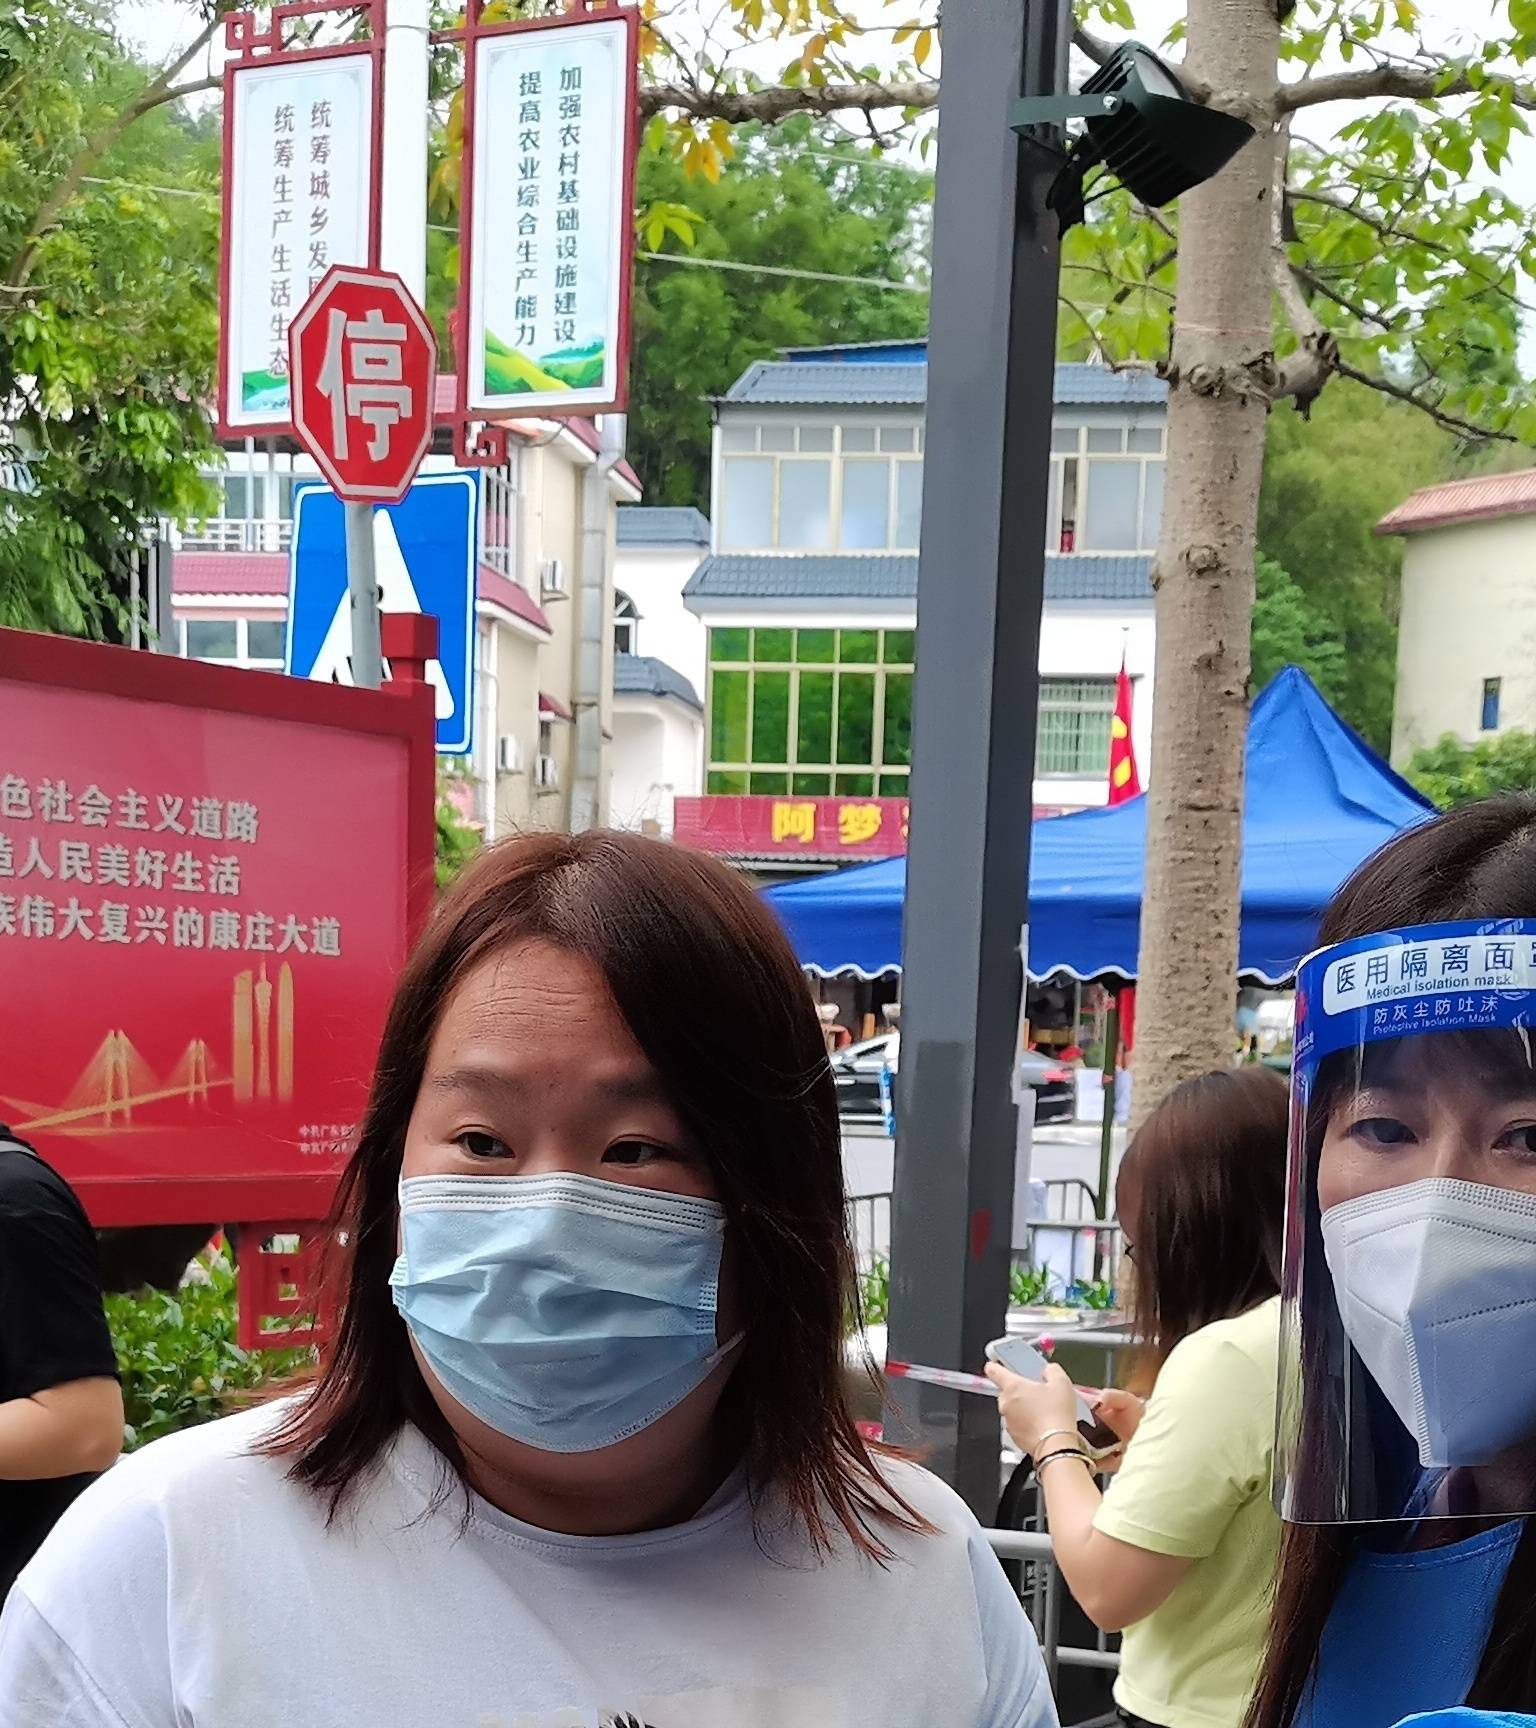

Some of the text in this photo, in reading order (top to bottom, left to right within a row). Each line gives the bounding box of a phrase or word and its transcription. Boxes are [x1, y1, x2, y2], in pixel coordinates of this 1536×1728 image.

[269, 104, 296, 377] 统筹生产生活生态
[514, 70, 542, 349] 提高农业综合生产能力
[553, 66, 582, 344] 加强农村基础设施建设
[316, 307, 414, 462] 停
[771, 801, 910, 845] 阿梦
[1367, 983, 1411, 1001] Medical
[1414, 977, 1470, 992] isolation
[1373, 995, 1499, 1025] 防灰尘防吐沫
